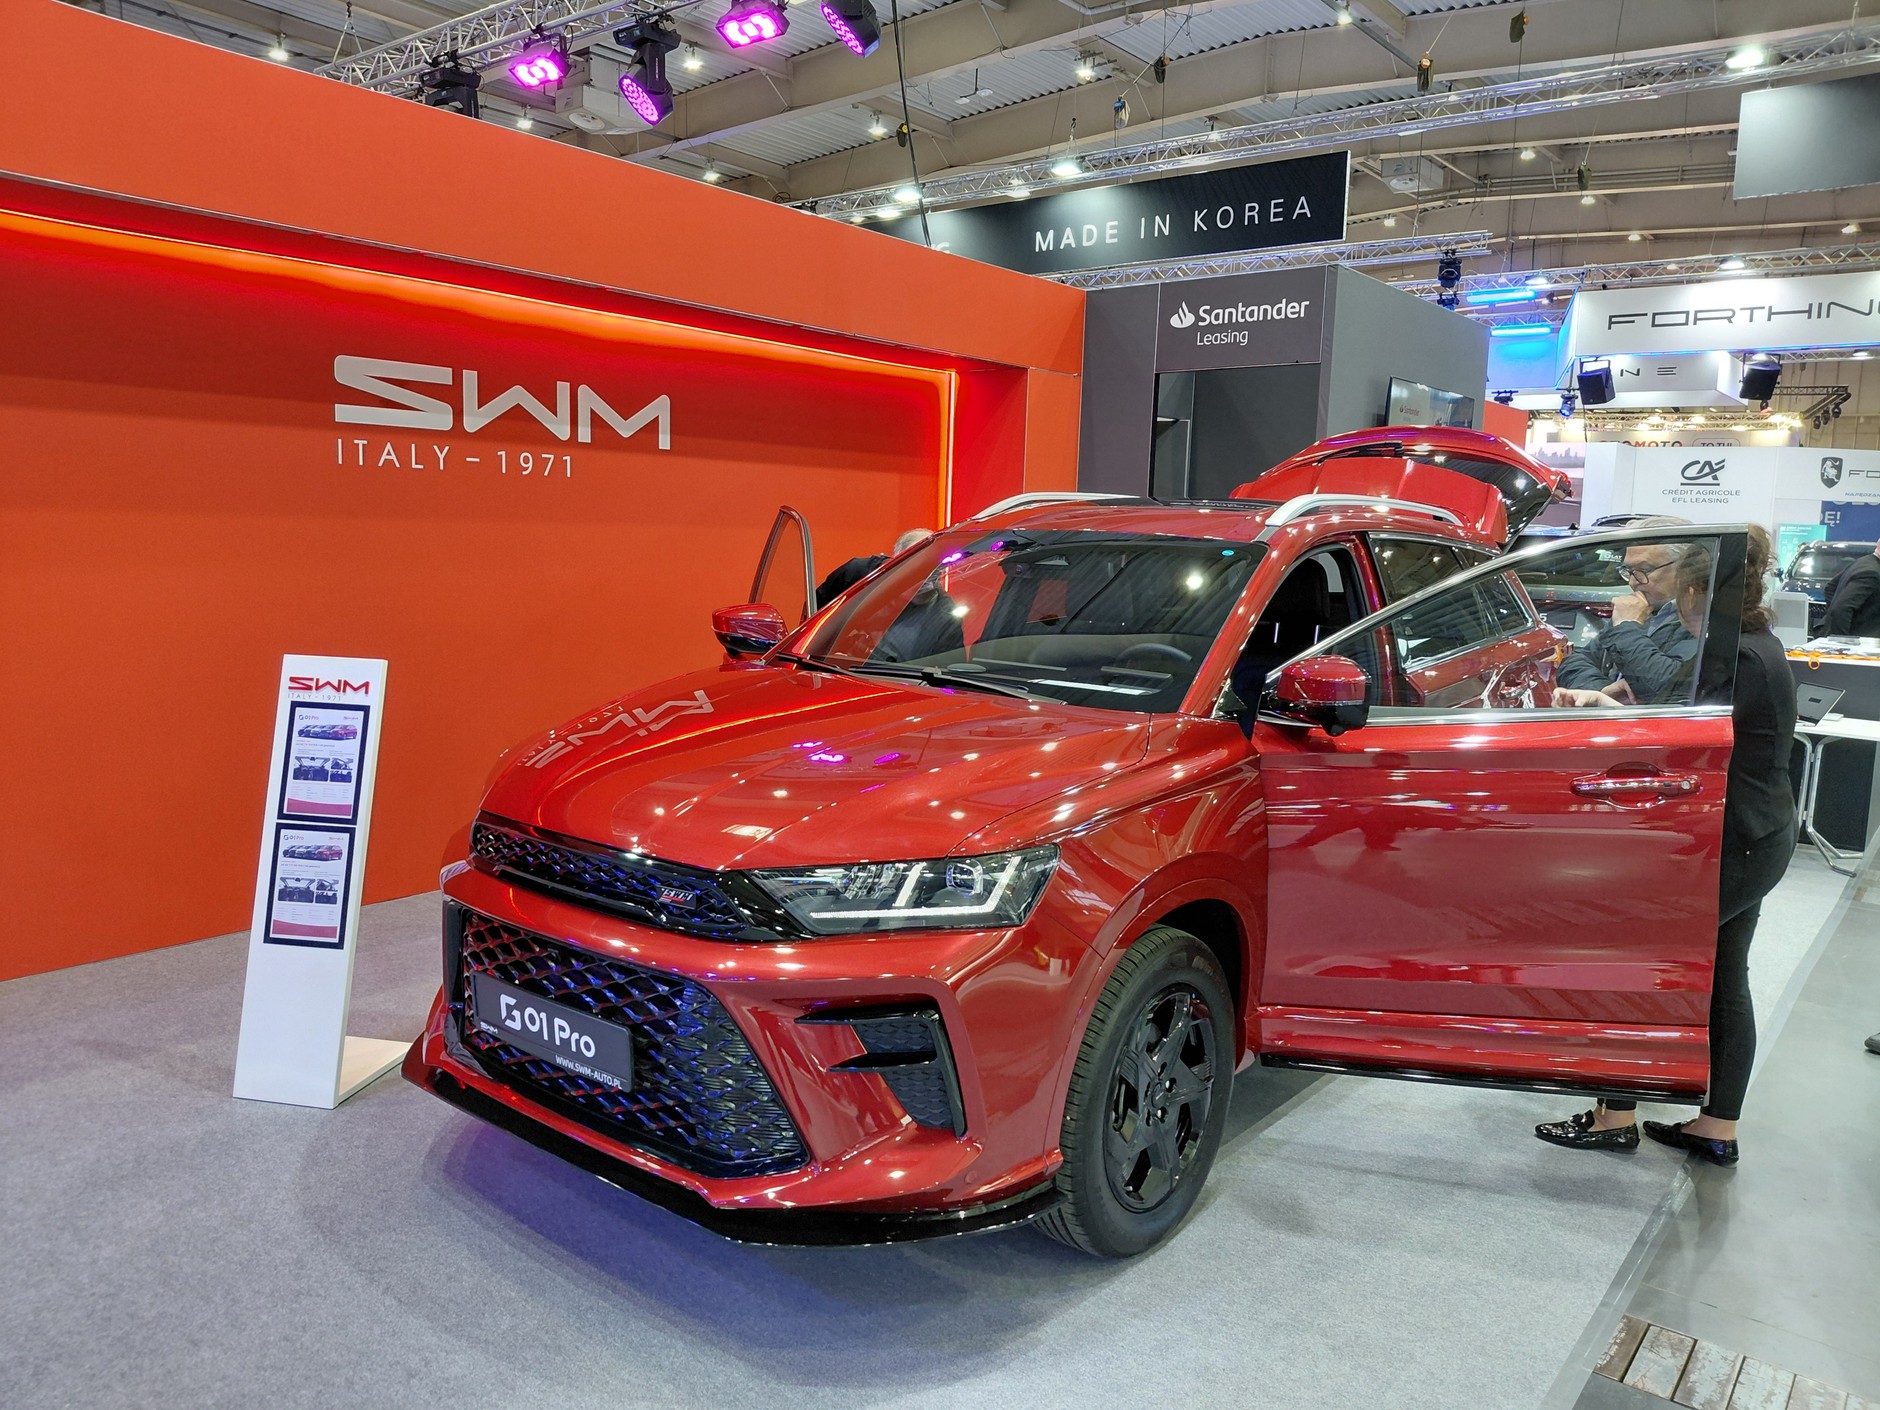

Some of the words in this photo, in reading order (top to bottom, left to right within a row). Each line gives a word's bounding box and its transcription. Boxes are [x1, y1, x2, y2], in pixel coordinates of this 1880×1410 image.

[1034, 220, 1120, 253] MADE
[1139, 212, 1171, 239] IN
[1193, 195, 1312, 233] KOREA
[1197, 298, 1310, 327] Santander
[1607, 298, 1880, 331] FORTHIN
[1196, 328, 1249, 347] Leasing
[333, 354, 671, 451] SWM
[336, 437, 450, 470] ITALY
[497, 450, 572, 478] 1971
[1662, 488, 1695, 496] CRÉDIT
[1820, 511, 1841, 527] Ę!
[287, 692, 312, 700] ITALY
[288, 676, 370, 695] SWM
[553, 1016, 596, 1058] Pro
[555, 1054, 623, 1090] WWW.SWM-AUTO.PL
